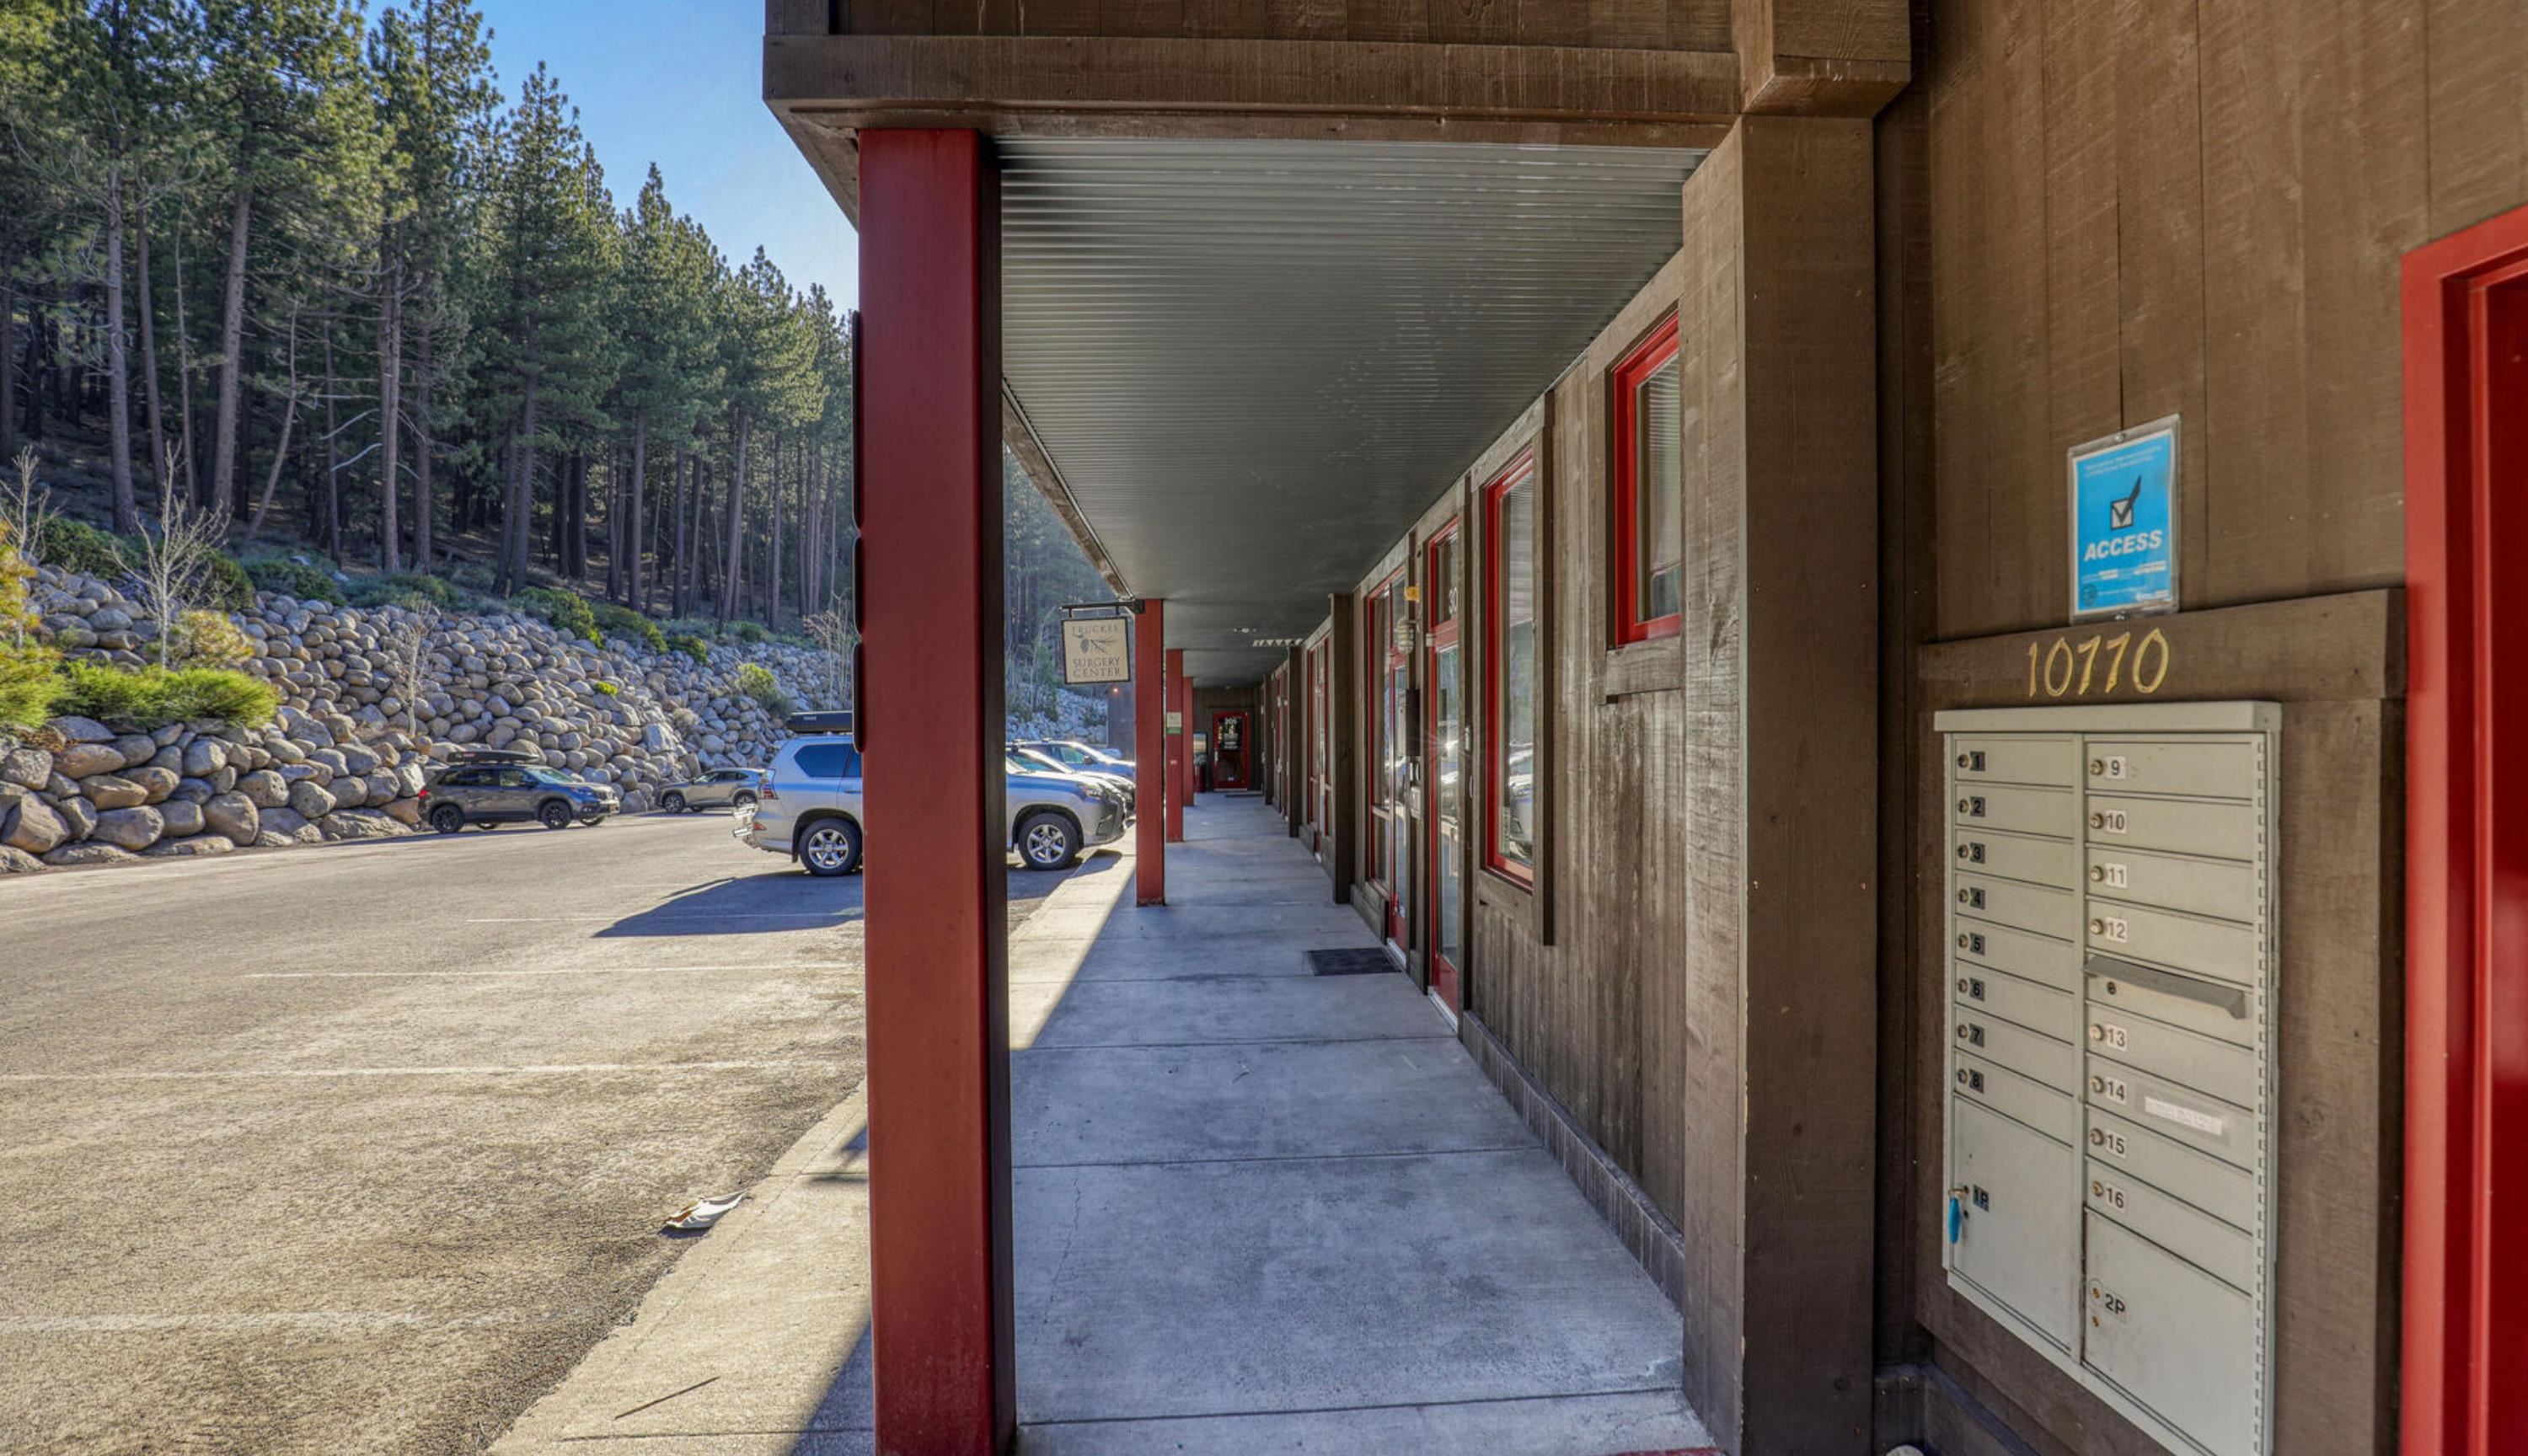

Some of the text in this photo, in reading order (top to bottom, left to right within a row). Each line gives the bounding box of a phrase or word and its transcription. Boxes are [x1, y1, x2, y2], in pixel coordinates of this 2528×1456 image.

[2083, 529, 2163, 562] ACCESS
[1071, 624, 1119, 634] TRUCKEE
[1073, 656, 1121, 668] SURGERY
[2027, 627, 2169, 698] 10770
[1073, 667, 1122, 678] CENTER
[2110, 760, 2121, 776] 9
[1974, 800, 1981, 815] 2
[2107, 813, 2125, 830] 10
[1974, 846, 1981, 860] 3
[2108, 867, 2125, 885] 11
[1974, 891, 1981, 905] 4
[2108, 922, 2126, 939] 12
[1974, 936, 1981, 951] 5
[1973, 982, 1980, 996] 6
[1973, 1027, 1980, 1042] 7
[2108, 1028, 2126, 1048] 13
[1972, 1073, 1980, 1088] 8
[2107, 1081, 2125, 1100] 14
[2107, 1134, 2125, 1154] 15
[1974, 1189, 1989, 1205] 1P
[2107, 1187, 2124, 1208] 16
[2105, 1293, 2125, 1315] 2P
